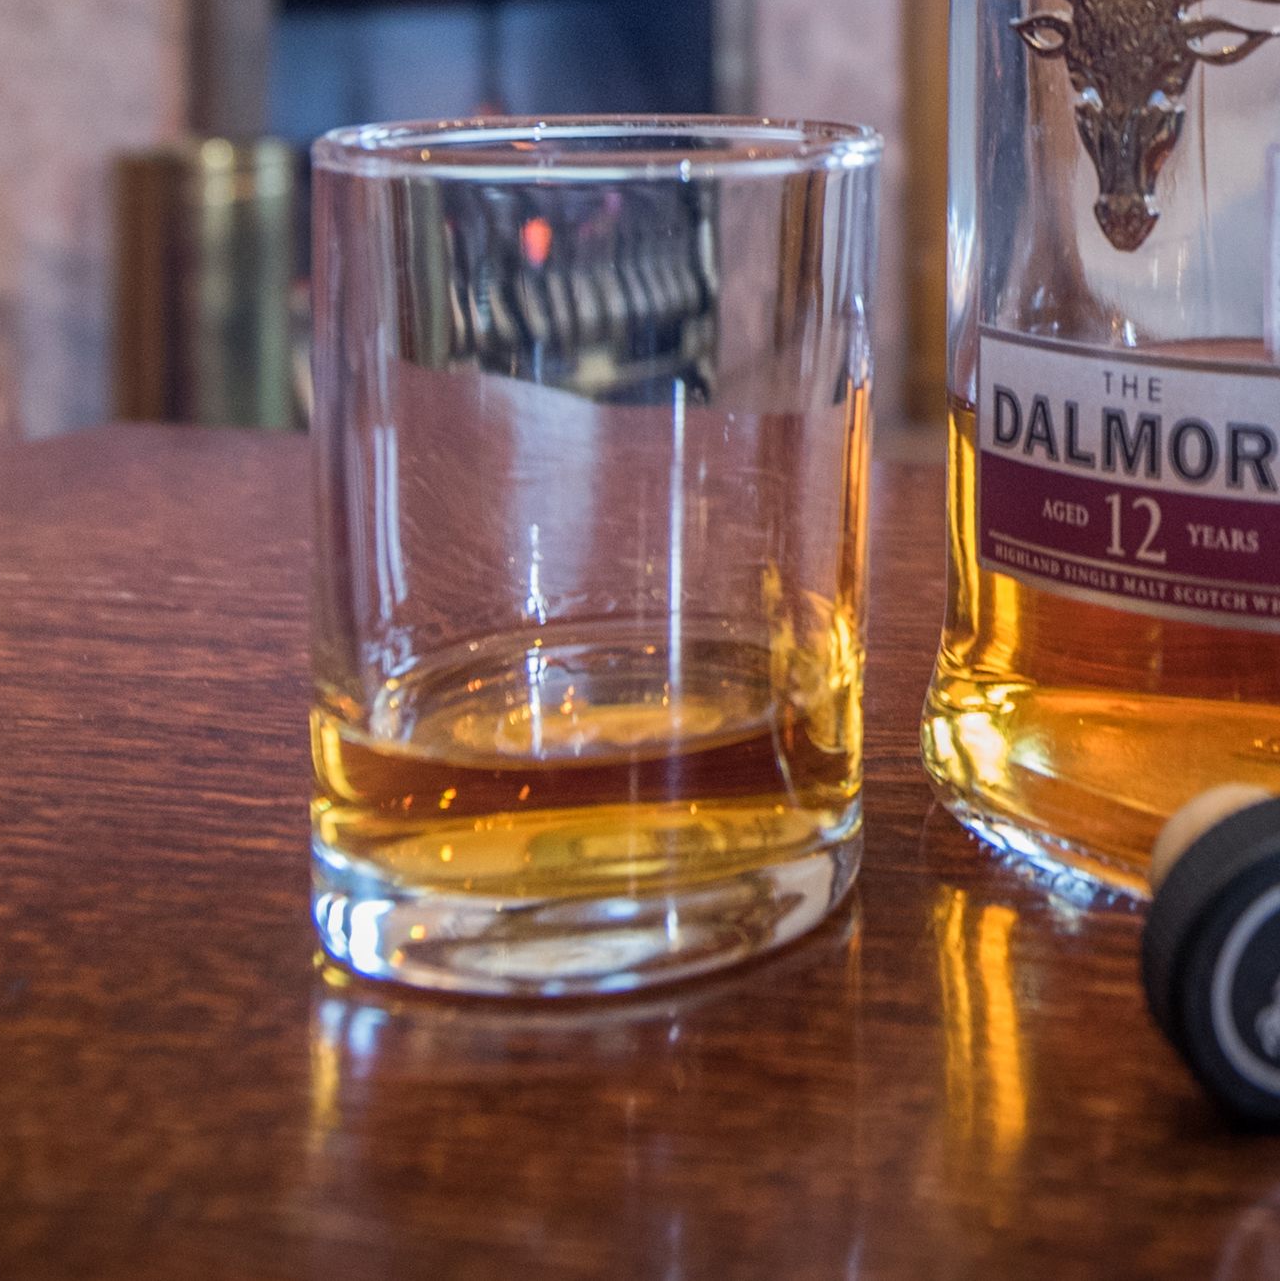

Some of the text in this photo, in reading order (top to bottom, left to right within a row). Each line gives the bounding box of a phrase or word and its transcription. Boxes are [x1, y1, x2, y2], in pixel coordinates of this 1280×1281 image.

[1103, 371, 1163, 402] THE
[1042, 493, 1260, 564] AGED 12 YEARS
[995, 543, 1060, 576] HIGHLAND
[1064, 564, 1119, 590] SINGLE
[1122, 576, 1168, 600] MALT
[1173, 585, 1248, 611] SCOTCH
